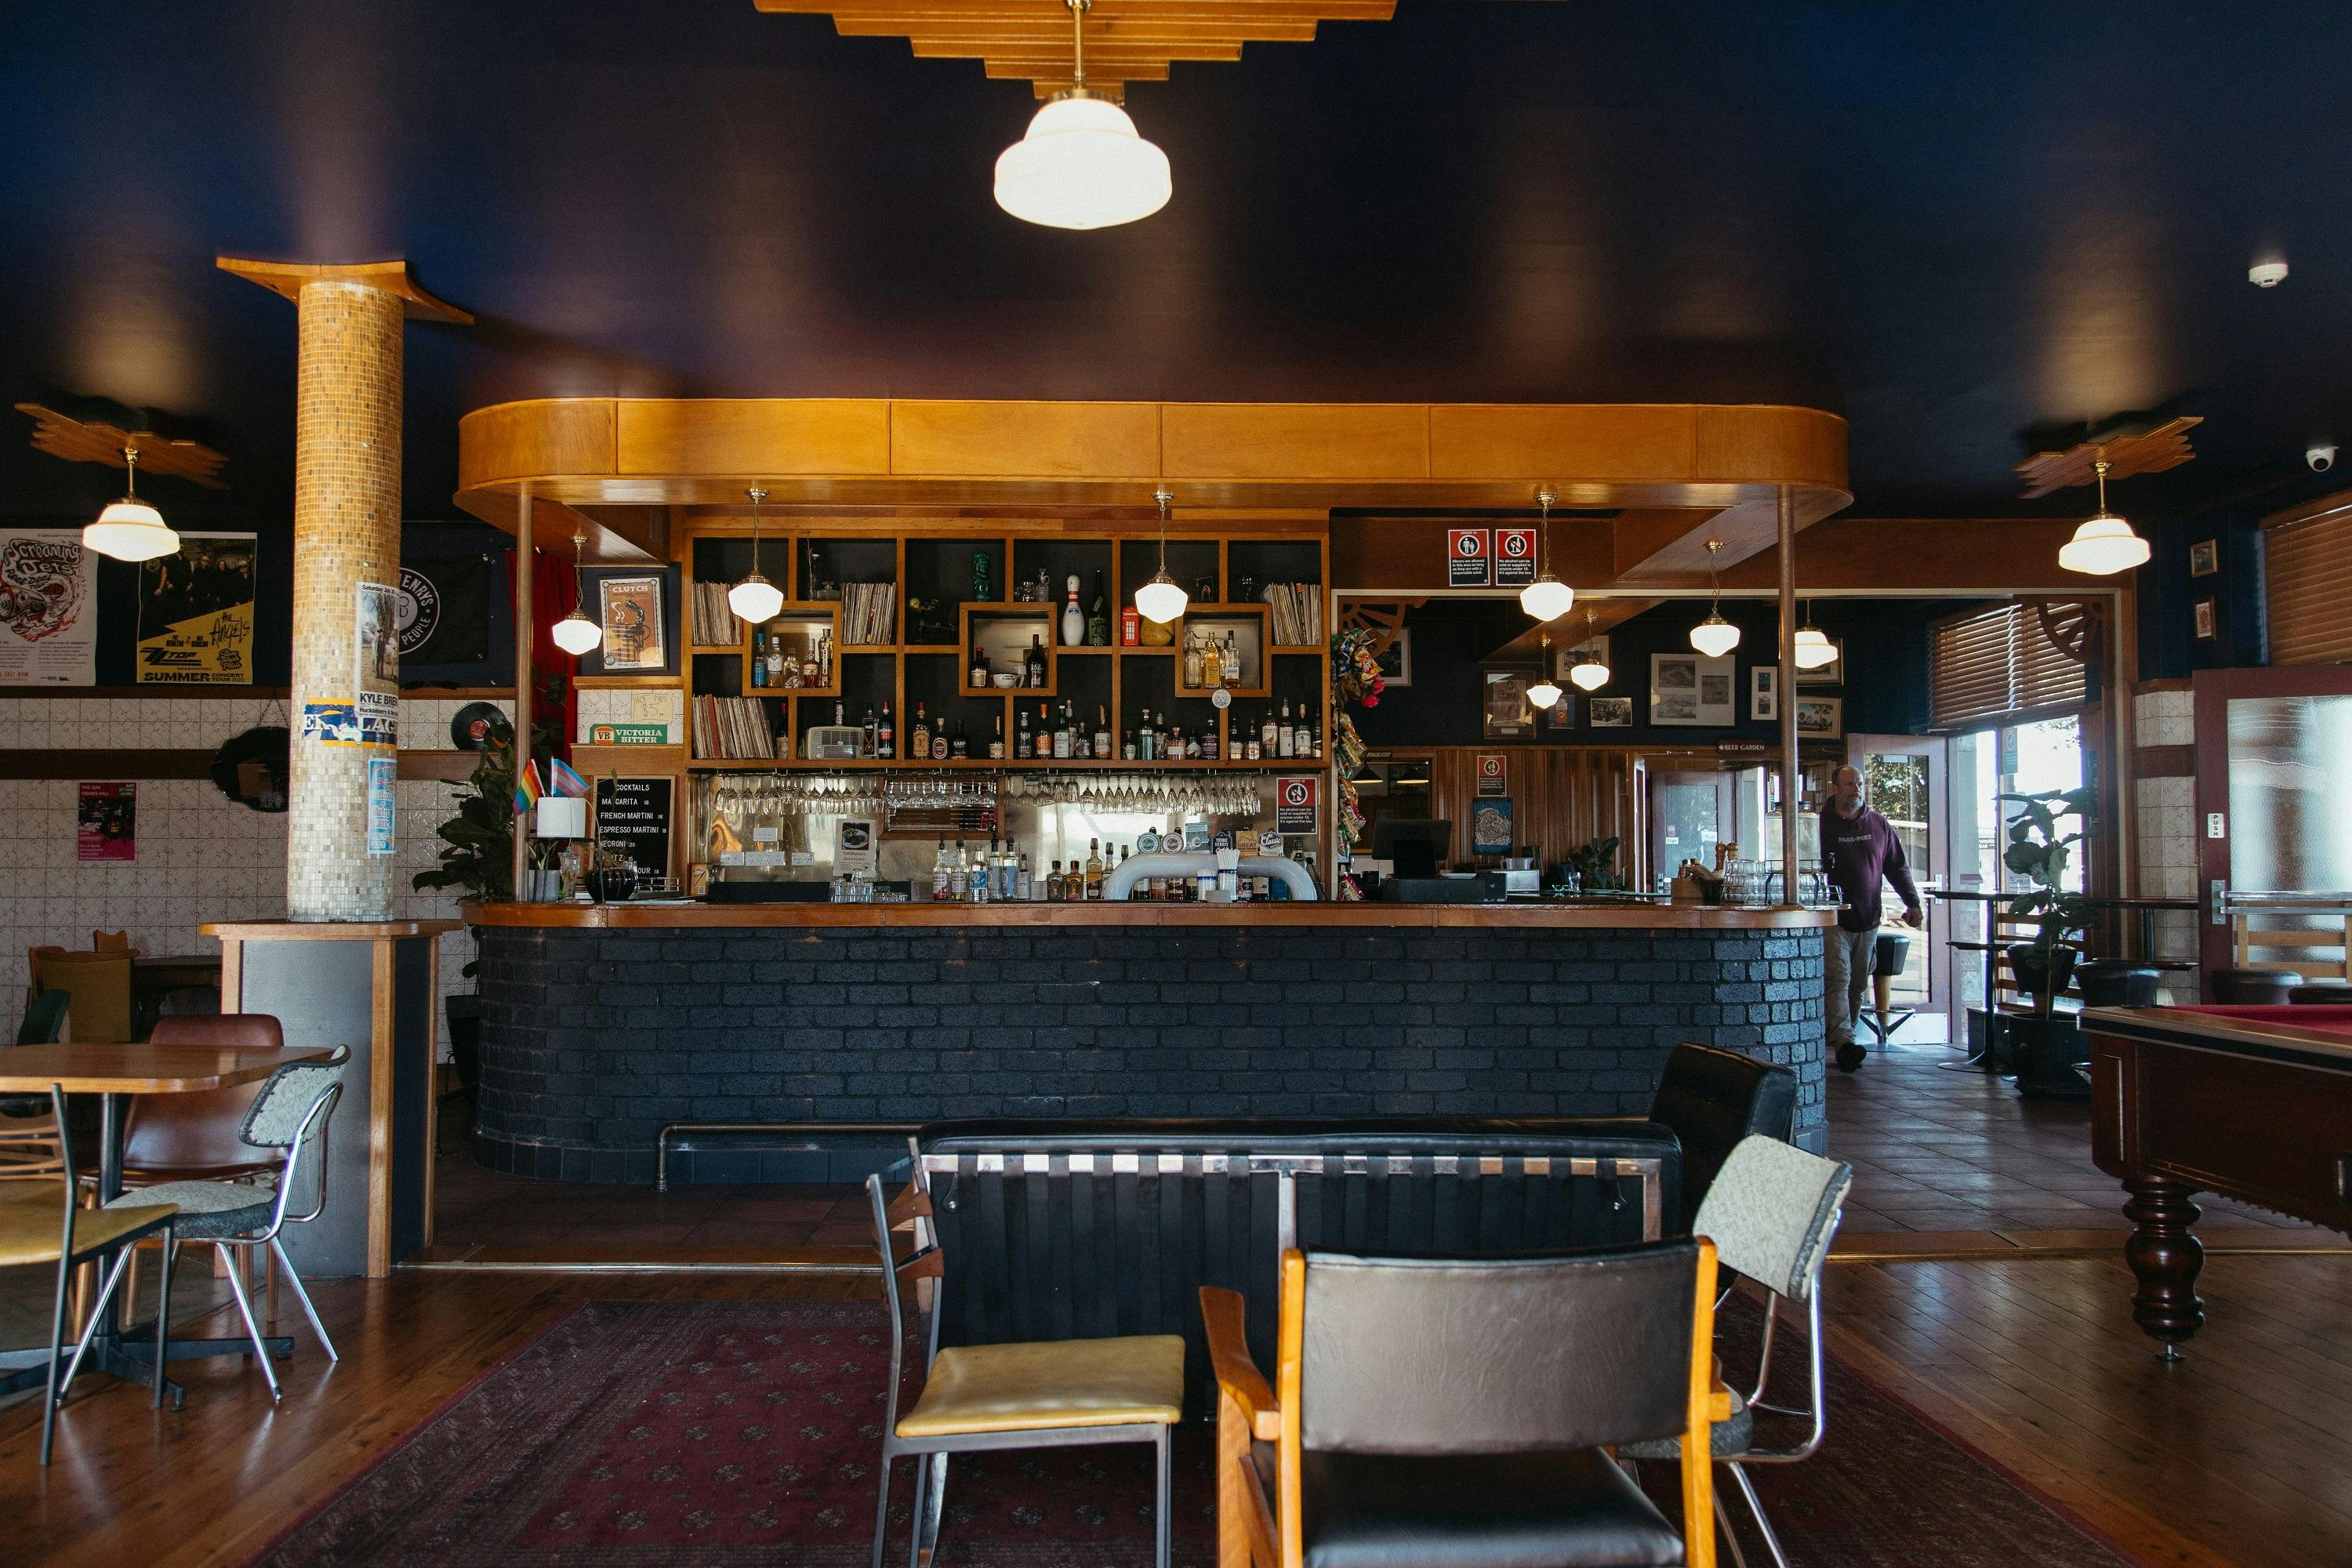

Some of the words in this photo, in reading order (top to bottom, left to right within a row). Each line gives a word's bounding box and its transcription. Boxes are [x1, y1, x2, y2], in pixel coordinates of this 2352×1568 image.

[400, 574, 434, 607] ENRYS
[401, 617, 431, 645] PEOPLE
[144, 673, 210, 681] SUMMER
[360, 692, 382, 704] KYLE
[359, 707, 387, 716] Huckleberry
[1261, 835, 1282, 845] Classic
